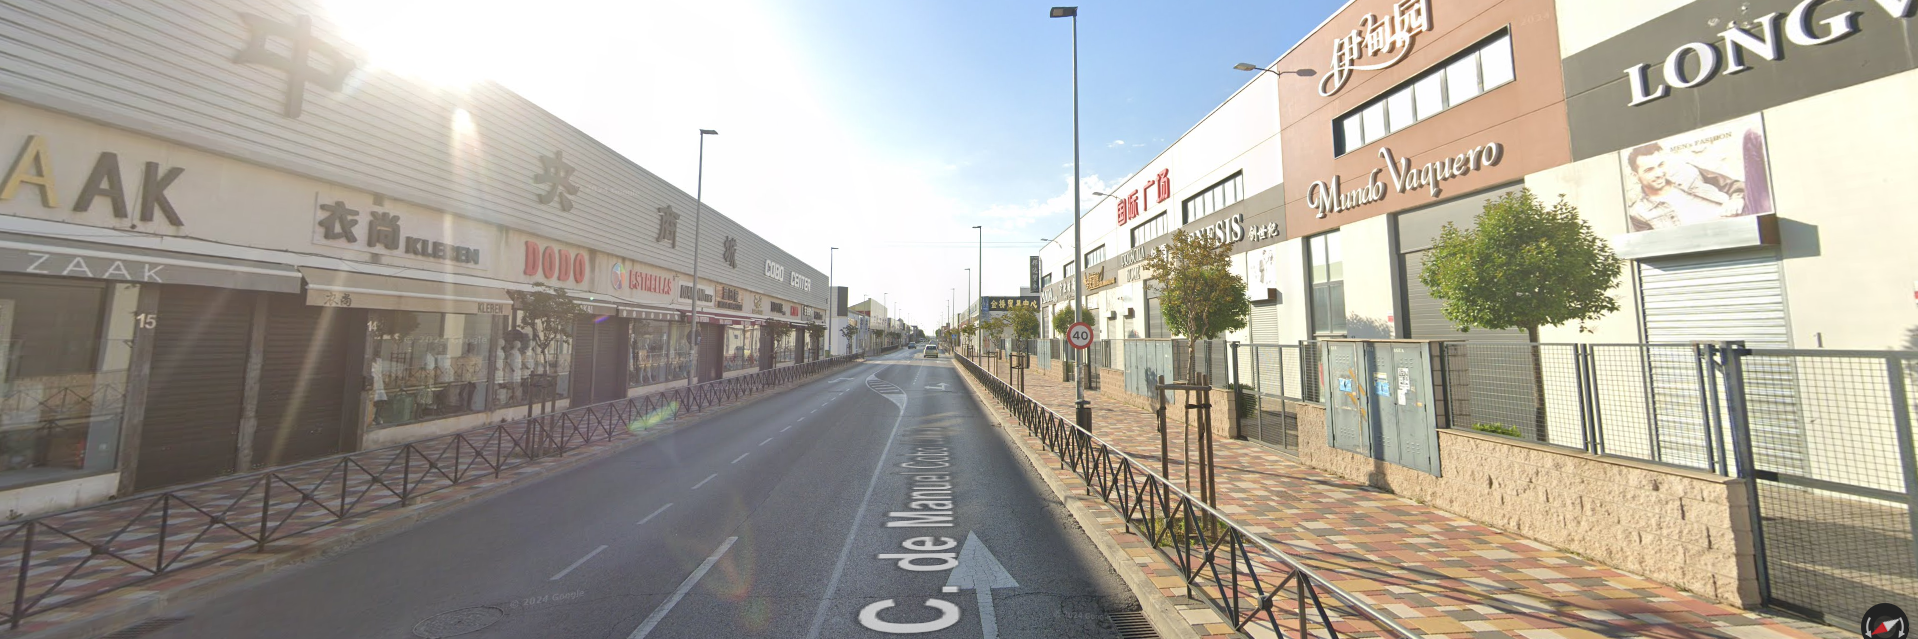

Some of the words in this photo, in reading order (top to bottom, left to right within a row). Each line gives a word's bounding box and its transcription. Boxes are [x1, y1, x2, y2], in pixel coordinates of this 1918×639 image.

[1624, 0, 1916, 107] LONG
[1307, 168, 1387, 219] Mundo
[1378, 142, 1503, 198] Vaquero
[1117, 168, 1171, 226] 国际广场
[318, 201, 400, 250] 衣尚
[1187, 213, 1245, 248] ENESIS
[1249, 221, 1280, 242] 创世纪
[26, 252, 165, 283] ZAAK
[523, 240, 586, 284] DODO
[765, 260, 784, 281] COBO
[790, 271, 811, 292] CENTER
[629, 269, 672, 295] ESTRELLAS
[136, 313, 157, 329] 15
[477, 303, 504, 315] KLEREN
[367, 321, 378, 332] 14
[1072, 331, 1089, 341] 40
